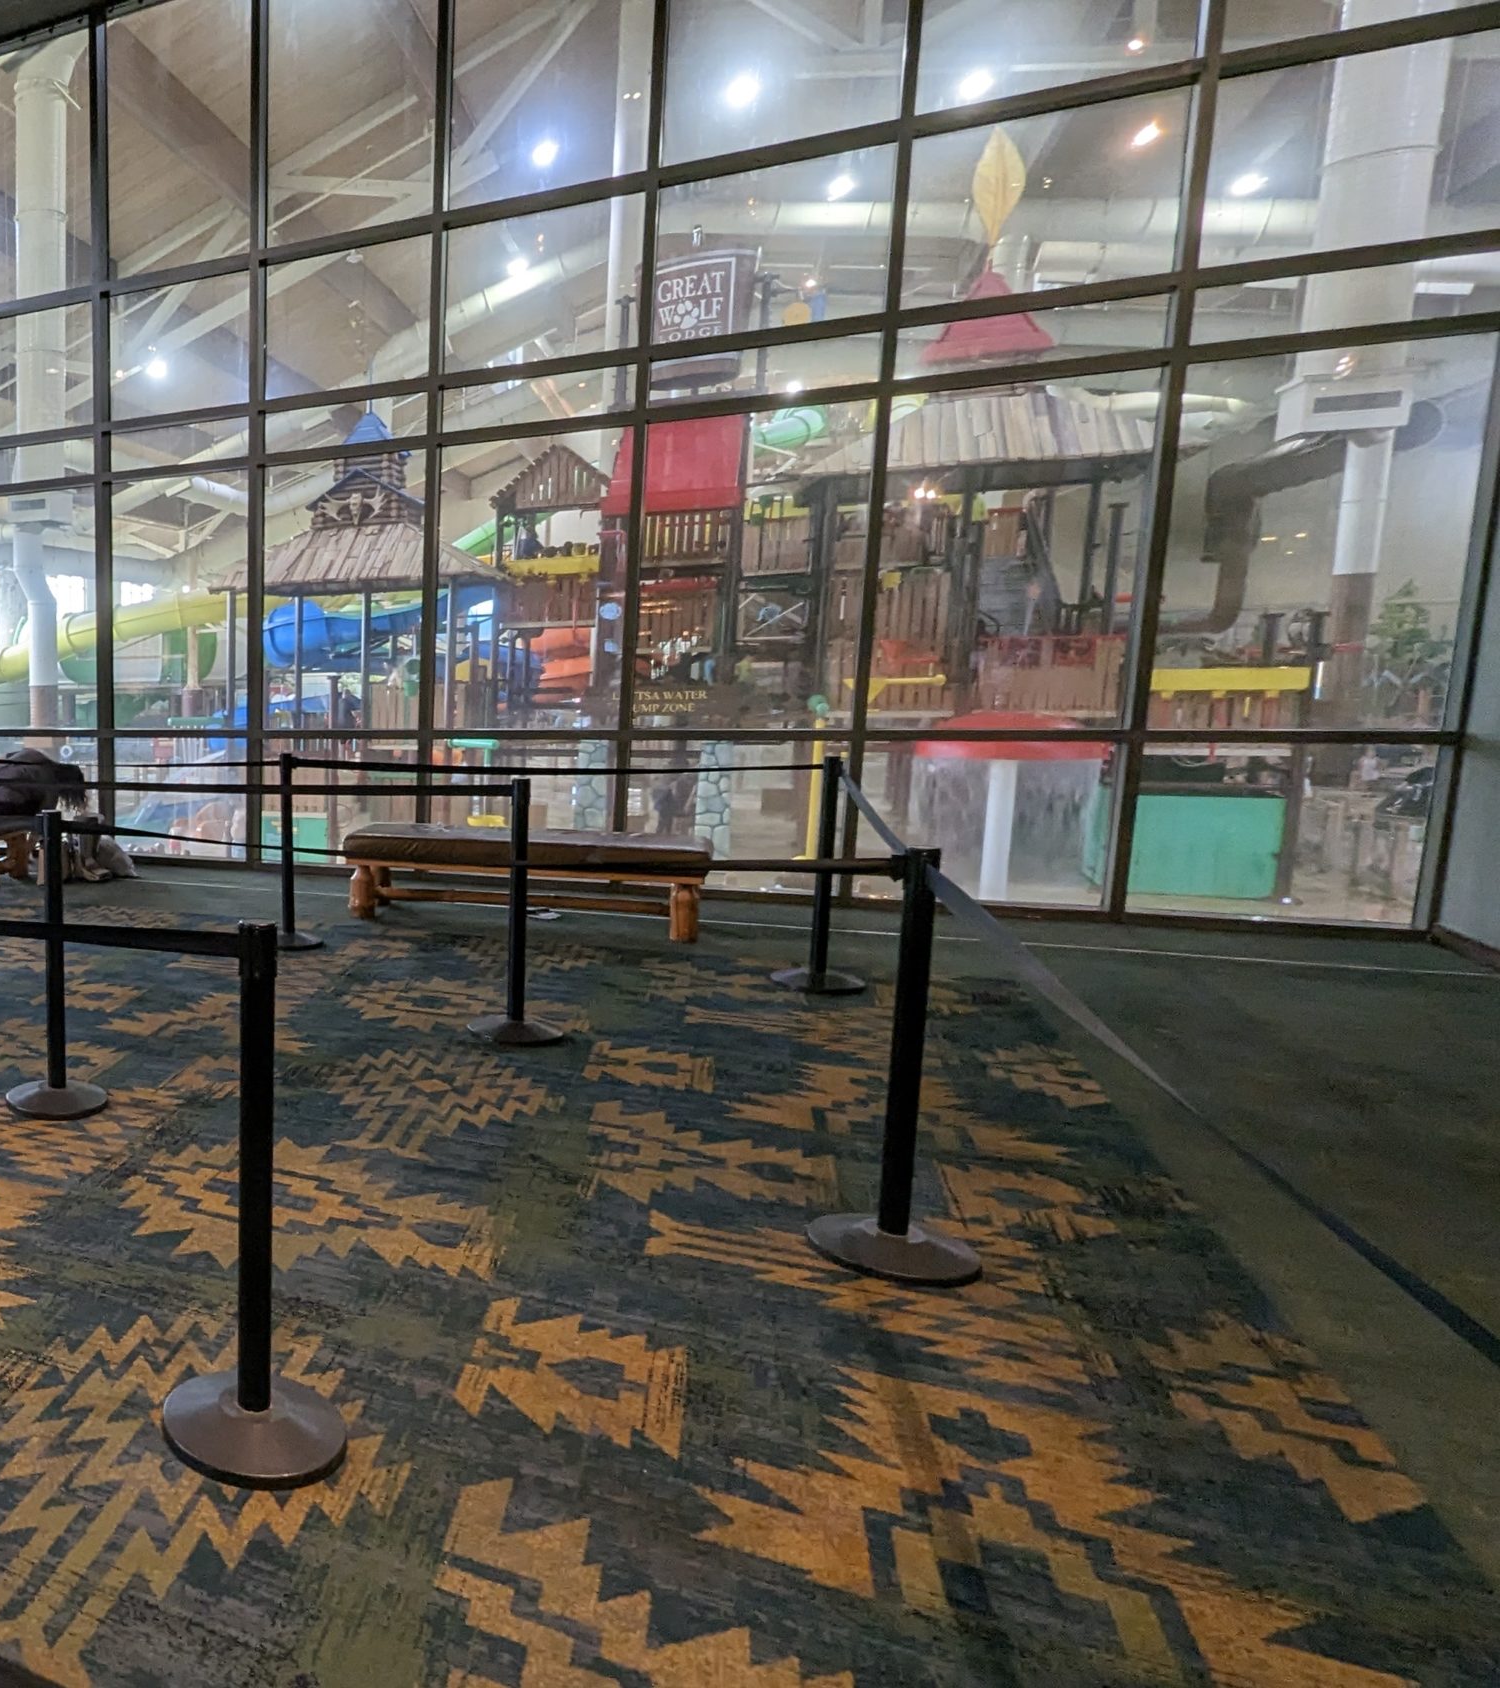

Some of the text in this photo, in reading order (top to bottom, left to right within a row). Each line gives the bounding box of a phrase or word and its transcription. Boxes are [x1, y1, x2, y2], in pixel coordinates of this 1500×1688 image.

[657, 271, 725, 304] GREAT
[659, 326, 723, 344] LODGE
[612, 690, 707, 700] LTSA WATER
[632, 702, 695, 712] UMP ZONE
